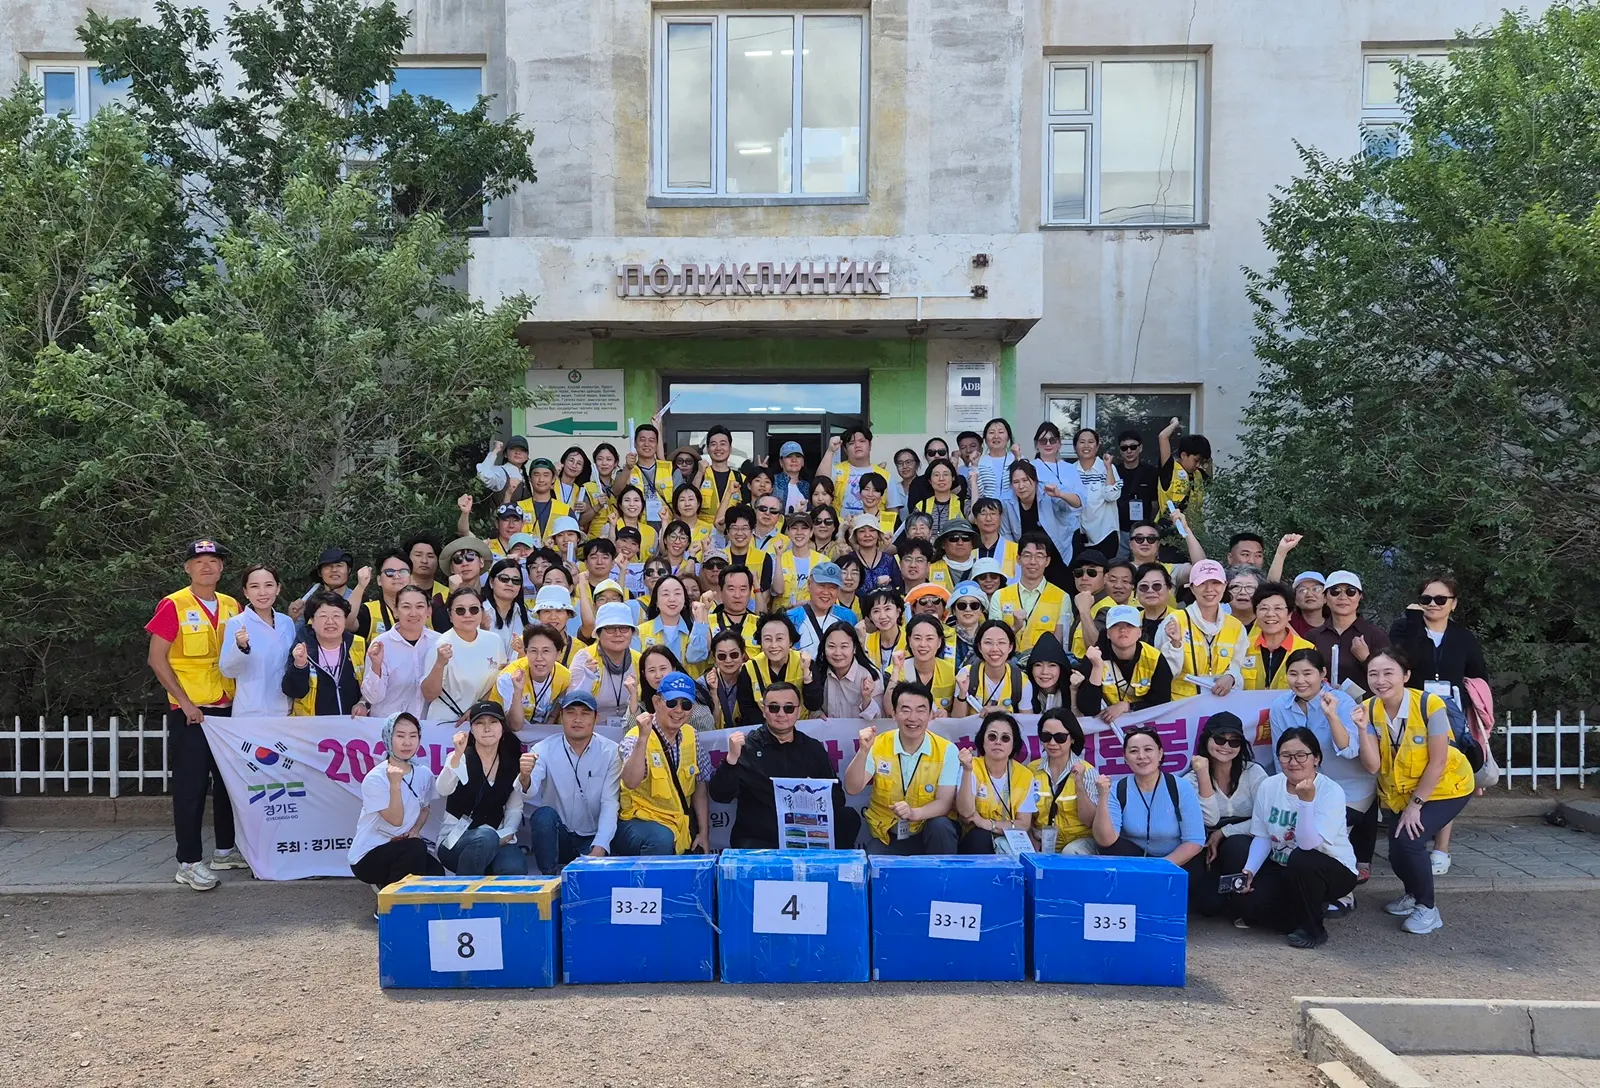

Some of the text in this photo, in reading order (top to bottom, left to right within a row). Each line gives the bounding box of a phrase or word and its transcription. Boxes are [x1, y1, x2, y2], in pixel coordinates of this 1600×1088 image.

[622, 261, 883, 297] ПОЛИКЛИНИК
[962, 382, 981, 391] ADB
[264, 803, 299, 816] 경기도
[709, 811, 730, 828] 일)
[277, 841, 300, 854] 주최
[615, 900, 657, 914] 33-22
[780, 894, 800, 921] 4
[934, 913, 976, 929] 33-12
[1093, 916, 1127, 930] 33-5
[457, 931, 475, 959] 8
